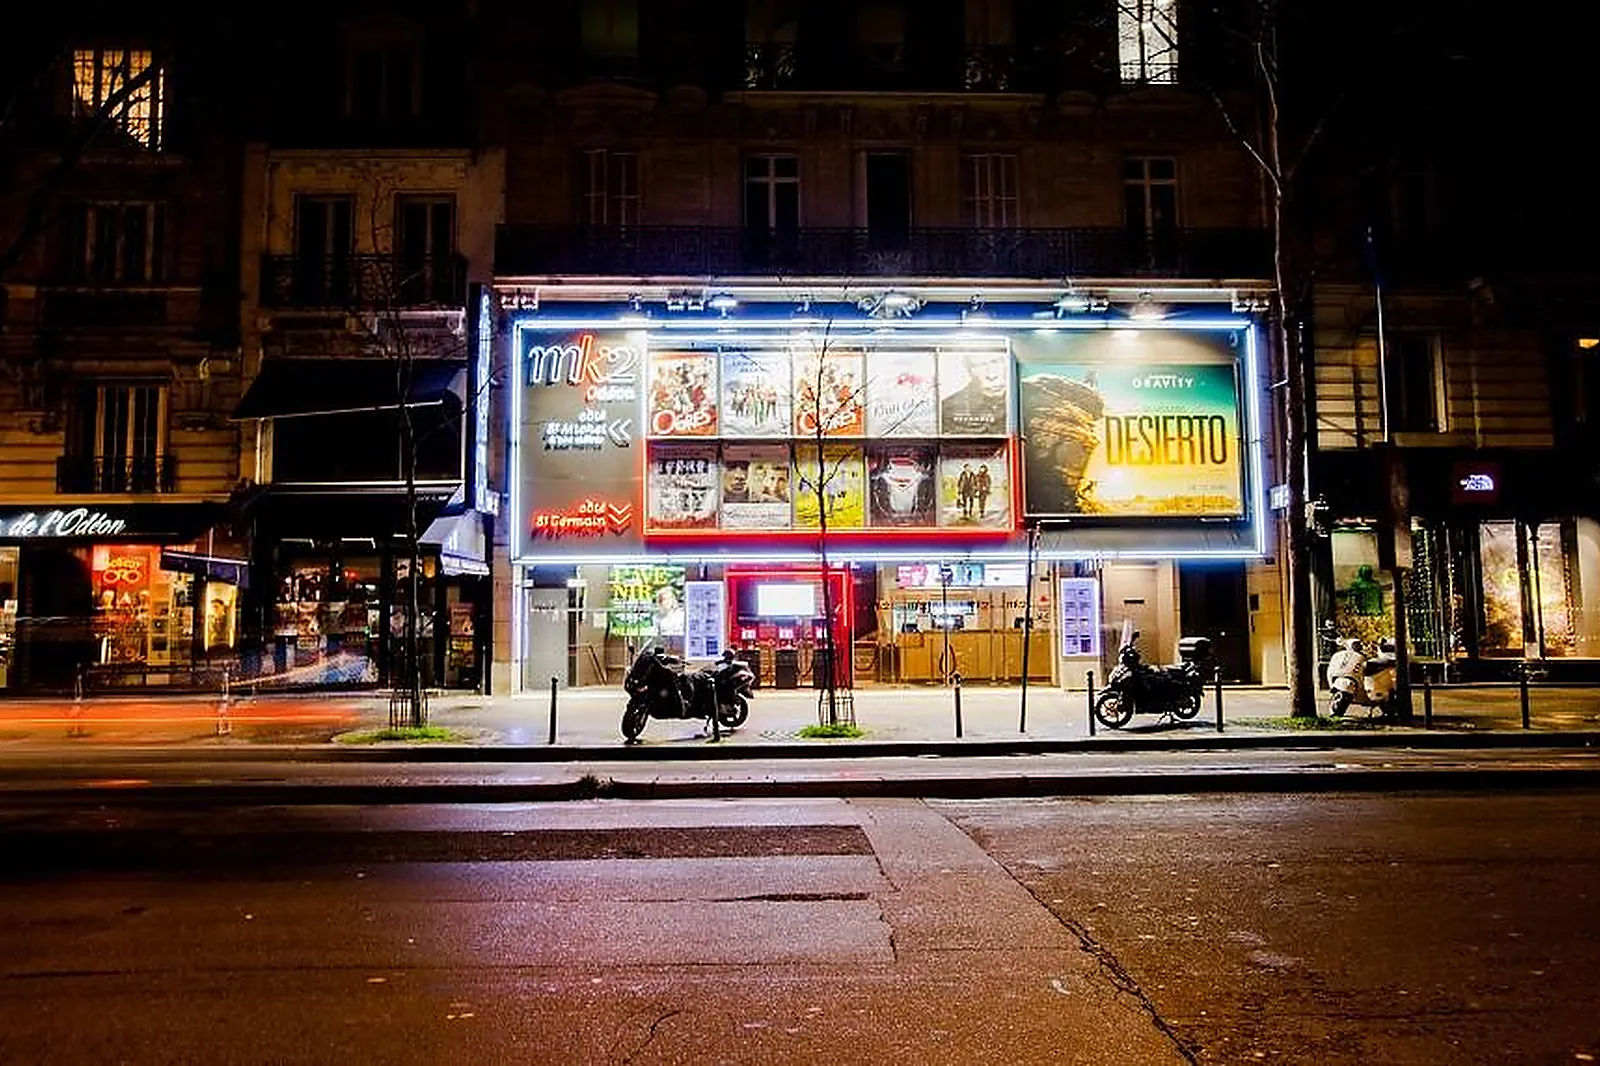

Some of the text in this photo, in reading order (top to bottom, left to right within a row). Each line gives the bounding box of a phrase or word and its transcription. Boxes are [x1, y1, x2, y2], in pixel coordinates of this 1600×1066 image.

[528, 334, 637, 384] mk2
[1132, 378, 1194, 388] GRAVITY
[1105, 414, 1228, 465] DESIERTO
[8, 507, 127, 536] de l'Odéon
